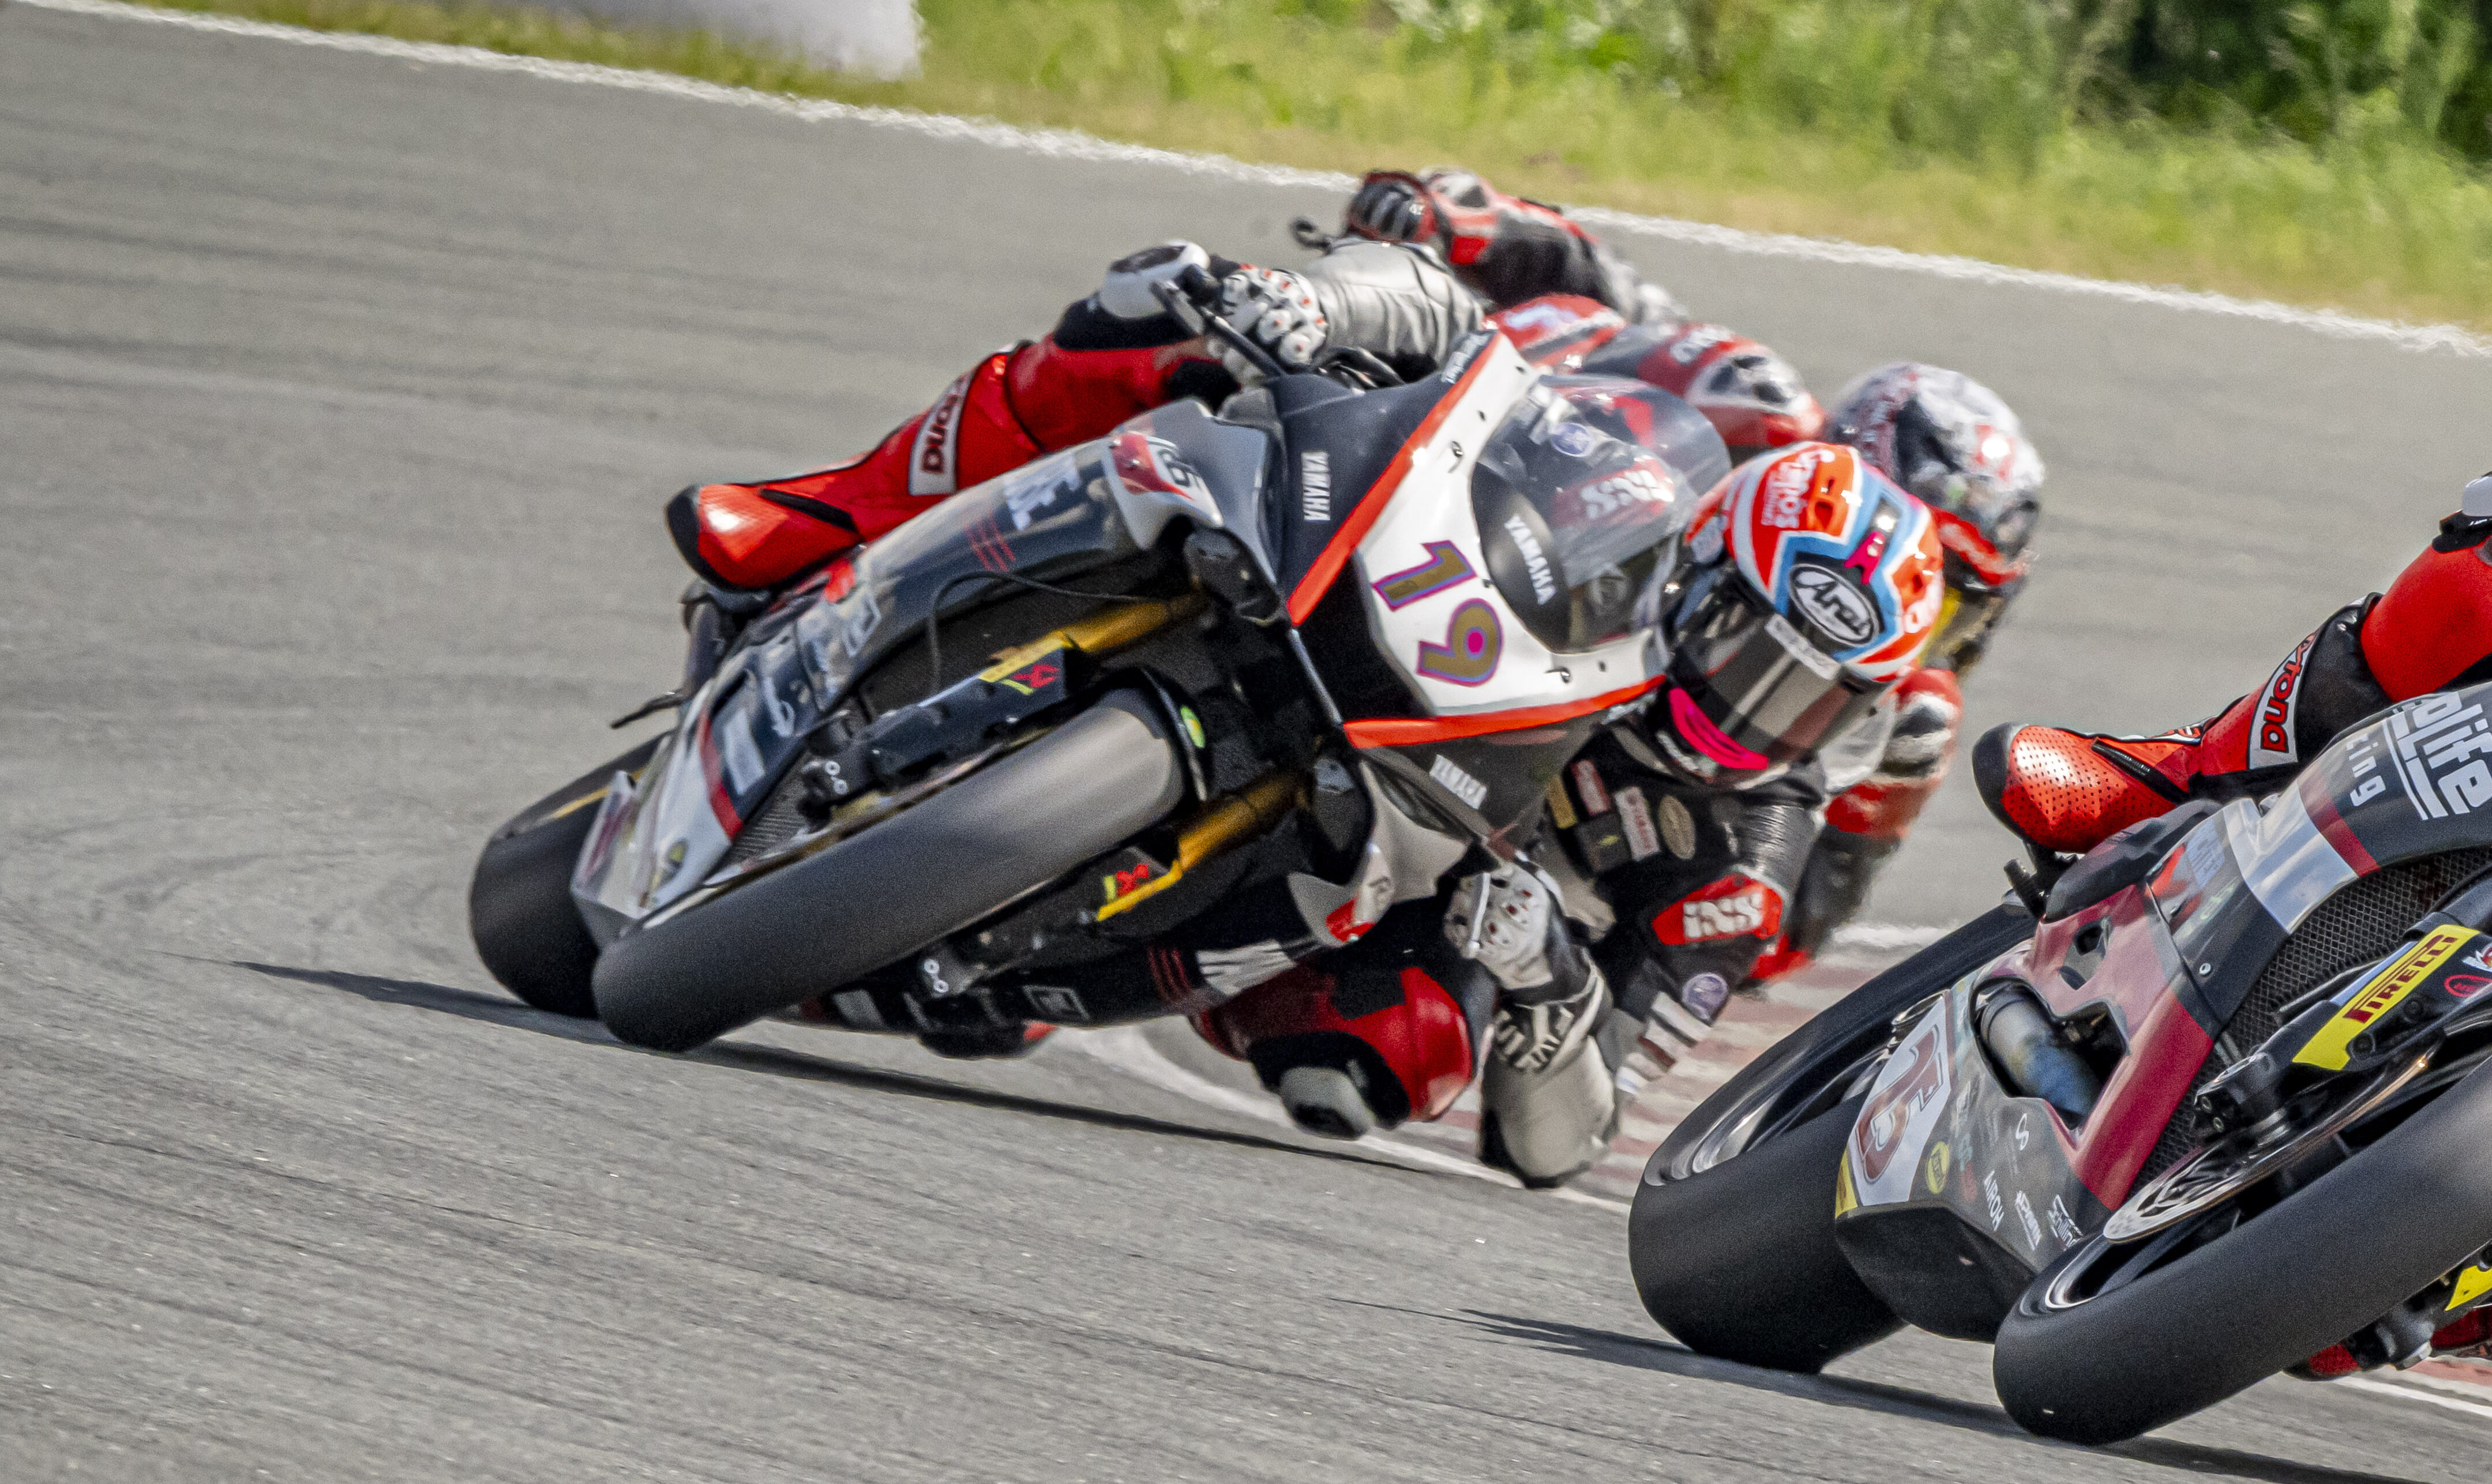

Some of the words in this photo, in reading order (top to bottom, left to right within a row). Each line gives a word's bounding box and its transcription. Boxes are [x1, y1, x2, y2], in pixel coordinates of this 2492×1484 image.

[1301, 451, 1331, 521] YAMAHA
[1504, 514, 1557, 605] YAMAHA
[1371, 539, 1504, 687] 19
[1429, 754, 1488, 809] YAMAHA
[2342, 934, 2459, 1024] PIRELLI
